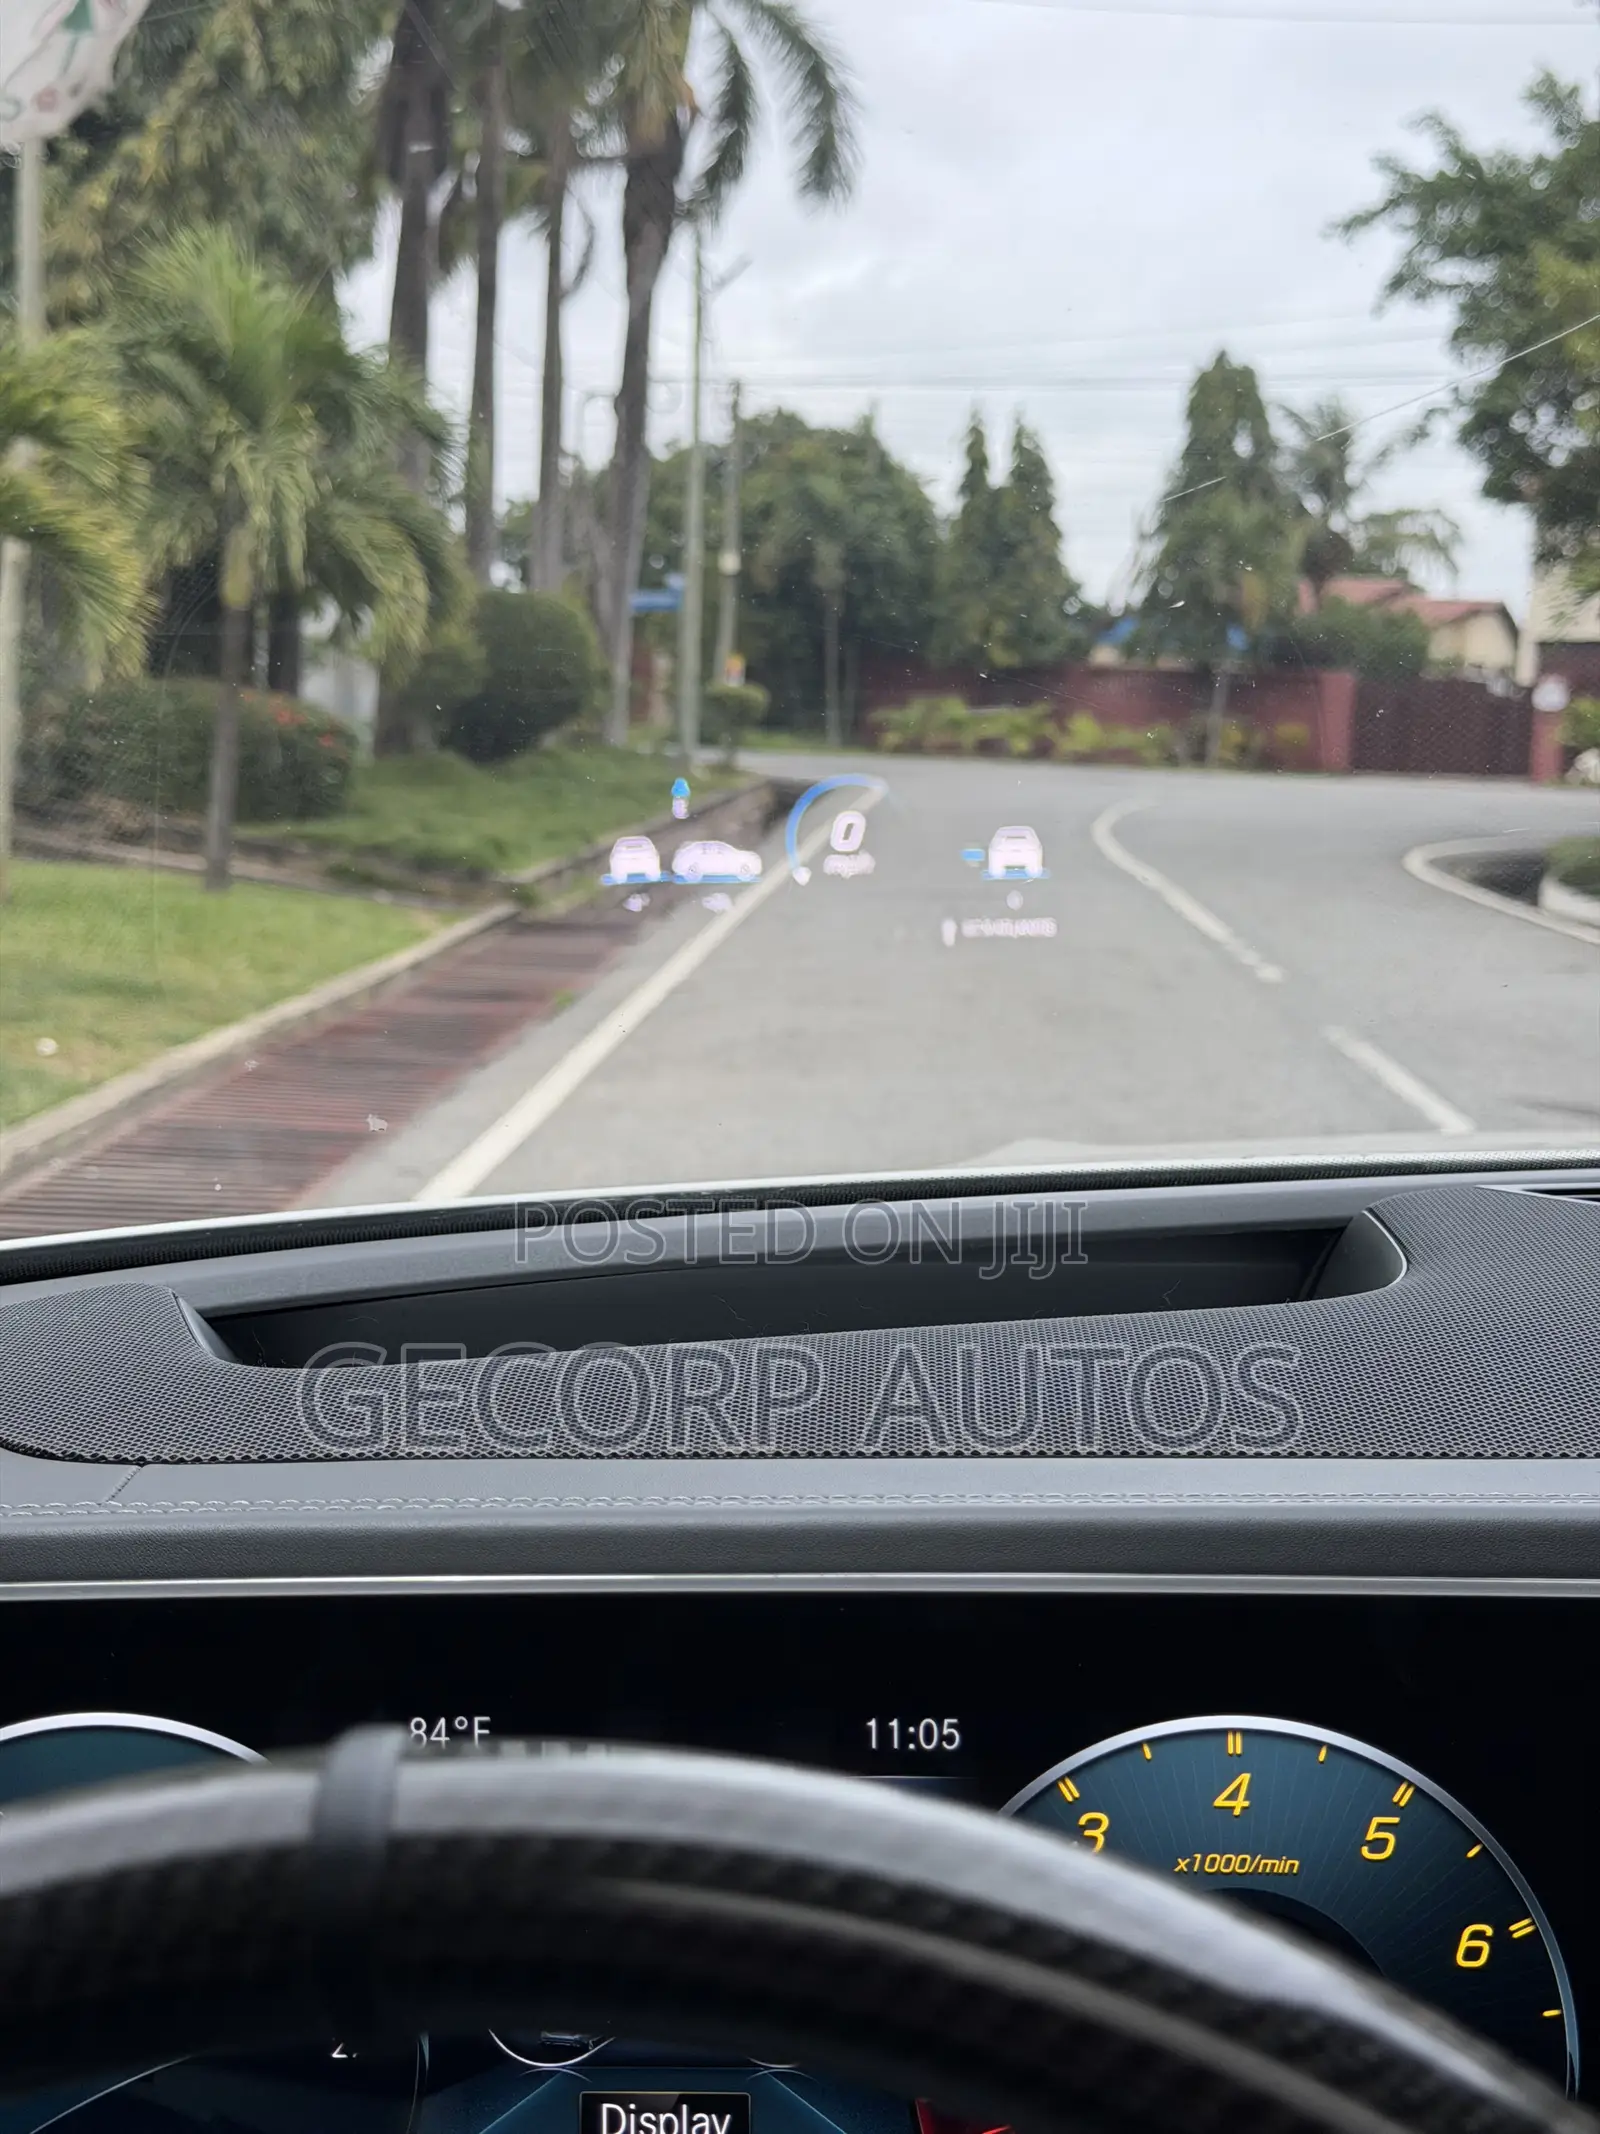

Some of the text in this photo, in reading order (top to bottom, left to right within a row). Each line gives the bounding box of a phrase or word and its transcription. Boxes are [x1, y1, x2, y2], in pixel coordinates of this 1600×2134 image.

[830, 810, 867, 852] 0
[409, 1715, 491, 1750] 84°F
[865, 1717, 962, 1751] 11:05
[1212, 1772, 1252, 1817] 4
[1077, 1811, 1110, 1854] 3
[1360, 1816, 1401, 1861] 5
[1173, 1853, 1300, 1876] x1000/min
[1455, 1923, 1495, 1968] 6
[601, 2102, 731, 2134] Display
